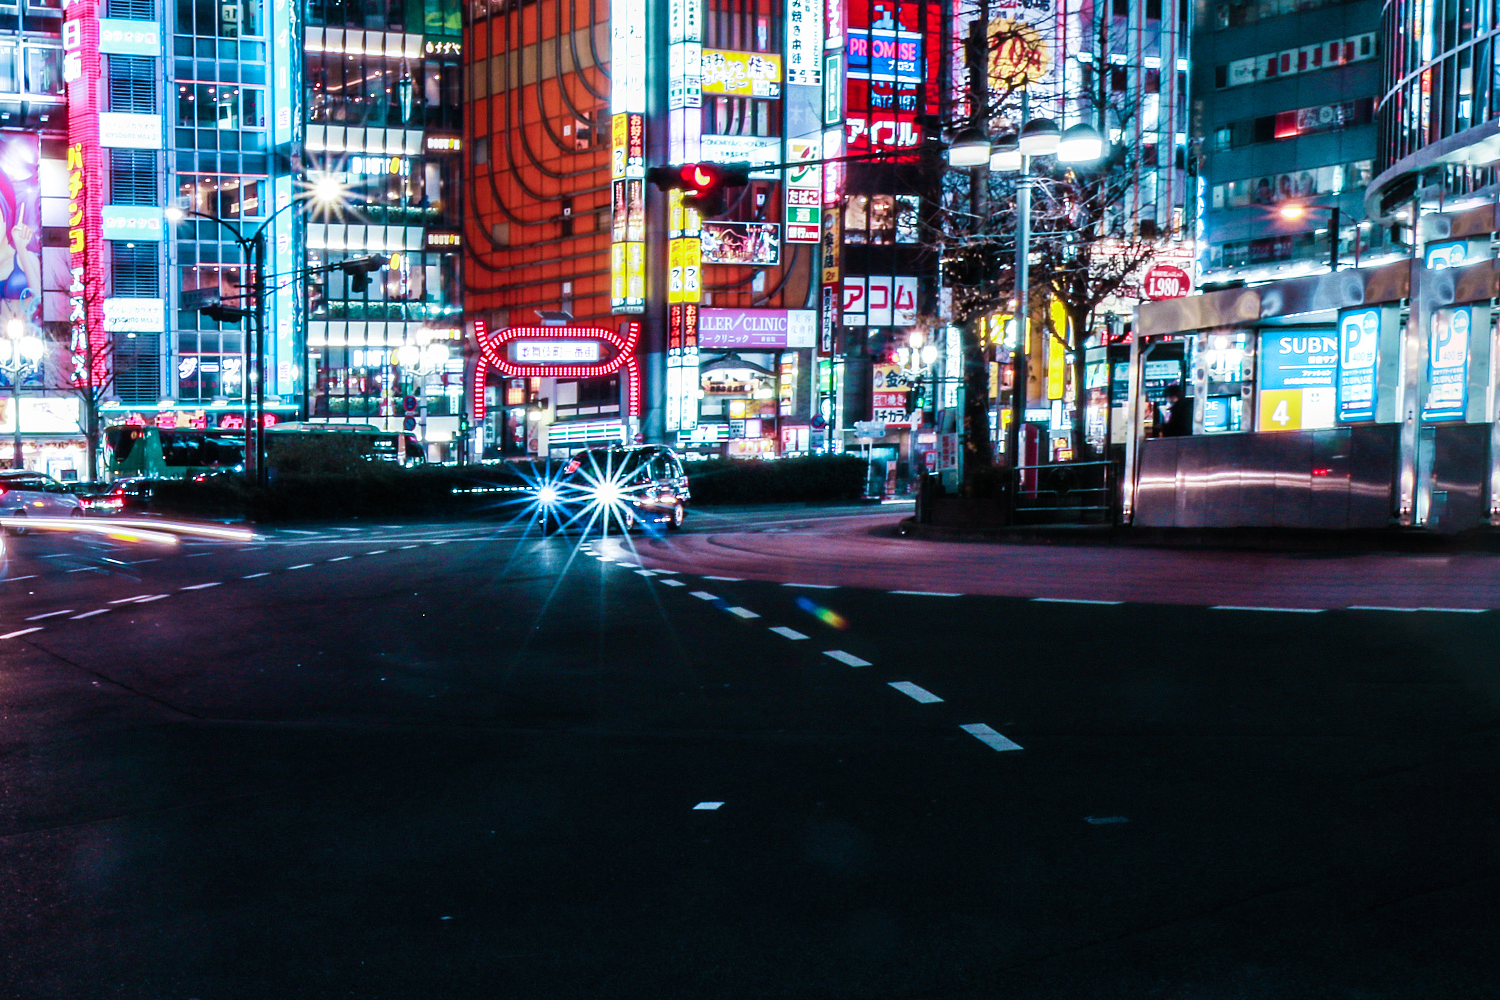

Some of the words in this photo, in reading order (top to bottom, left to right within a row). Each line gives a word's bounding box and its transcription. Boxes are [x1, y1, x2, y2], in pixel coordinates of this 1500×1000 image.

[850, 38, 917, 61] PROMISE
[846, 118, 919, 147] アイフル
[67, 142, 85, 254] パチンコ
[788, 190, 818, 205] たばこ
[796, 208, 811, 222] 酒
[826, 272, 836, 281] 2F
[843, 284, 914, 309] アコム
[70, 267, 88, 382] エスパス
[699, 316, 732, 331] LLER
[743, 318, 787, 331] CLINIC
[1345, 323, 1361, 363] P
[1272, 400, 1290, 425] 4
